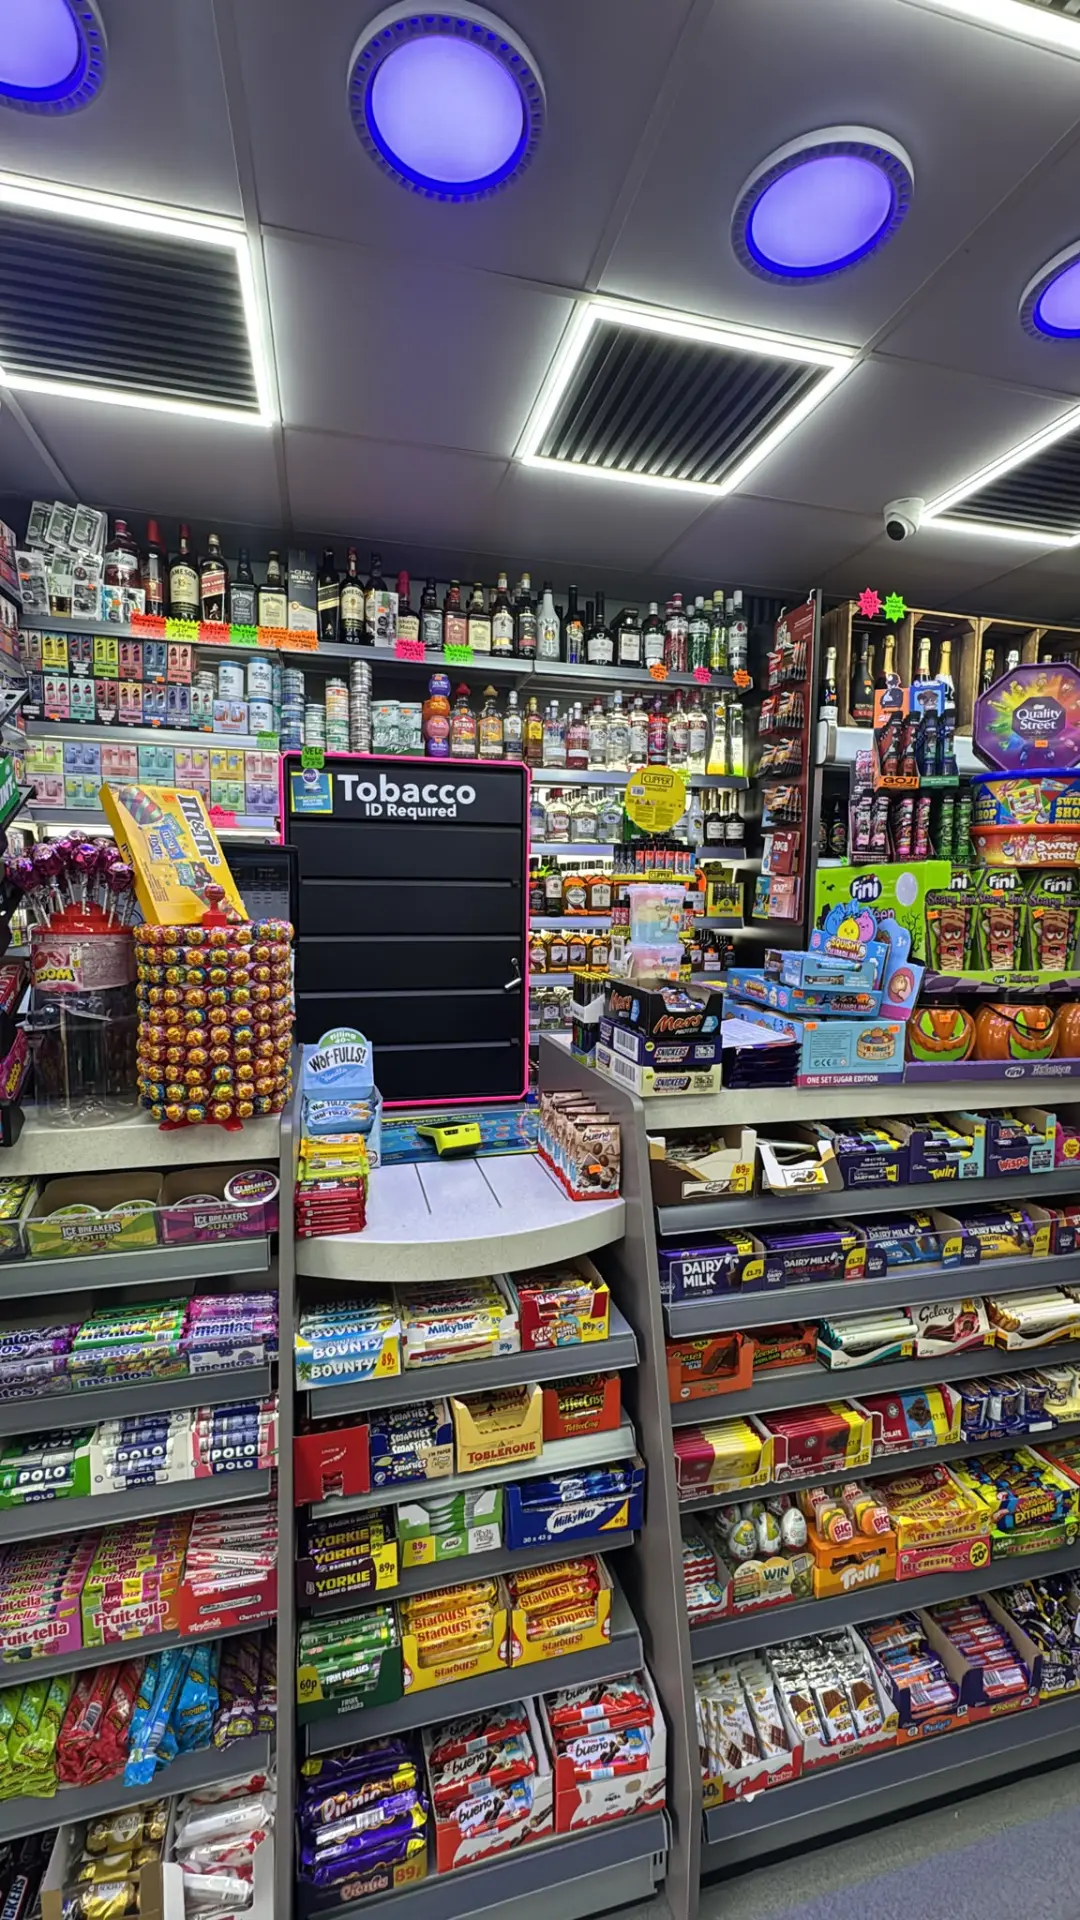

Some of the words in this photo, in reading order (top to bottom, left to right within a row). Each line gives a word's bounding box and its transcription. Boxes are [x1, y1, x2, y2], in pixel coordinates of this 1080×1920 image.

[1016, 707, 1062, 722] Quality
[1019, 720, 1057, 731] Street
[643, 773, 672, 786] CLIPPER
[337, 773, 476, 805] Tobacco
[1056, 796, 1080, 806] SWEE
[365, 803, 383, 817] ID
[387, 803, 457, 820] Required
[1055, 806, 1080, 818] SHO
[1036, 840, 1079, 853] Sweet
[1037, 850, 1076, 861] Treats
[851, 876, 880, 900] Fini
[988, 874, 1016, 890] Fini
[1043, 877, 1073, 892] Fini
[830, 937, 861, 951] SQUISHY
[653, 1014, 703, 1034] Mars
[654, 1046, 688, 1058] SNICKERS
[654, 1076, 688, 1088] SNICKERS
[806, 1076, 820, 1084] ONE
[820, 1075, 832, 1084] SET
[832, 1075, 852, 1083] SUGAR
[853, 1074, 878, 1083] EDITION
[582, 1131, 610, 1143] bueno
[735, 1164, 750, 1176] 89p
[998, 1156, 1029, 1172] Wispa
[929, 1166, 956, 1180] Twirl
[194, 1213, 207, 1227] ICE
[208, 1211, 249, 1224] BREAKERS
[61, 1223, 76, 1238] ICE
[76, 1222, 122, 1235] BREAKERS
[869, 1230, 892, 1240] DAIRY
[892, 1228, 910, 1238] MILK
[969, 1227, 990, 1236] DAIRY
[991, 1224, 1008, 1234] MILK
[682, 1258, 724, 1276] DAIRY
[784, 1259, 809, 1268] DAIRY
[809, 1255, 830, 1265] MILK
[683, 1273, 717, 1289] MILK
[918, 1306, 956, 1323] Galaxy
[195, 1320, 253, 1337] mentos
[311, 1322, 378, 1339] BOUNTY
[427, 1320, 475, 1336] Milkybar
[582, 1321, 596, 1332] 89p
[312, 1336, 384, 1360] BOUNTY
[499, 1342, 512, 1351] 89p
[195, 1358, 254, 1374] mentos
[381, 1352, 395, 1366] 89p
[311, 1358, 377, 1380] BOUNTY
[78, 1369, 153, 1388] mentos
[390, 1426, 431, 1445] SMARTIES
[117, 1444, 164, 1462] POLO
[210, 1443, 256, 1460] POLO
[467, 1441, 536, 1465] TOBLERONE
[215, 1459, 254, 1472] POLO
[393, 1458, 427, 1475] SMARTIES
[18, 1466, 66, 1483] POLO
[126, 1475, 155, 1485] POLO
[750, 1472, 768, 1484] £1.15
[25, 1492, 55, 1503] POLO
[1014, 1500, 1056, 1523] EXTREME
[834, 1520, 852, 1534] BIG
[917, 1522, 977, 1541] REFRESHERS
[314, 1527, 370, 1549] YORKIE
[412, 1541, 428, 1551] 89p
[313, 1543, 370, 1564] YORKIE
[378, 1562, 396, 1574] 89p
[902, 1552, 969, 1573] REFRESHERS
[315, 1569, 371, 1592] YORKIE
[763, 1565, 790, 1581] WIN
[840, 1563, 881, 1591] Trolli
[318, 1586, 340, 1598] RAISIN
[347, 1580, 372, 1592] BISCUIT
[519, 1584, 571, 1608] Starburst
[93, 1600, 169, 1626] Fruit-tella
[0, 1622, 69, 1647] ruit-tella
[416, 1619, 472, 1643] Starburst
[541, 1633, 584, 1652] Starburst
[434, 1657, 479, 1678] Starburst
[299, 1678, 318, 1691] 60p
[574, 1739, 609, 1758] bueno
[451, 1749, 485, 1776] bueno
[458, 1798, 493, 1825] bueno
